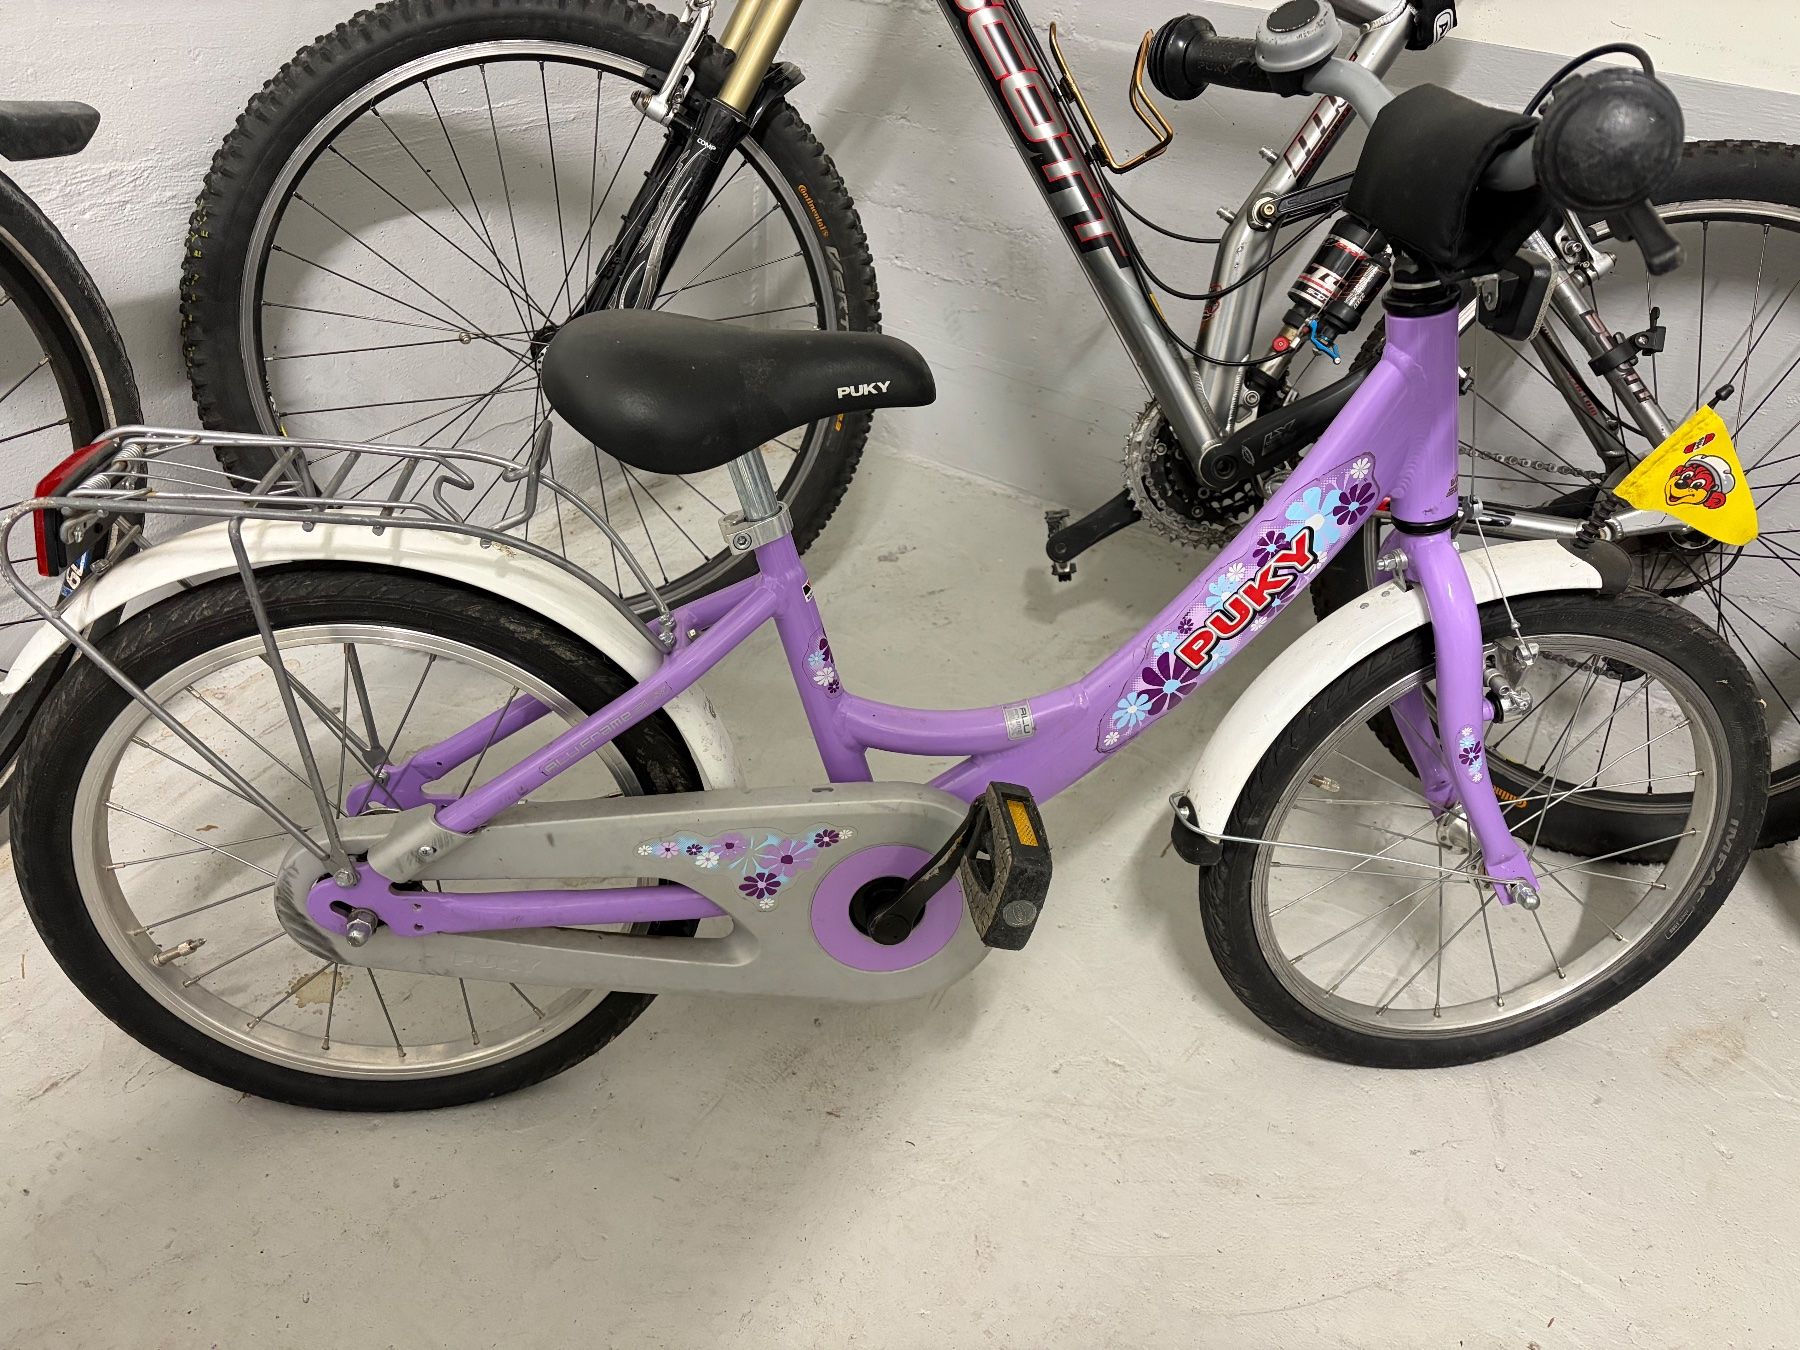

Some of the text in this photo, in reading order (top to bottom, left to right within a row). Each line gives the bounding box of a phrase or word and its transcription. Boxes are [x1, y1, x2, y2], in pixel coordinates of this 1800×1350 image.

[954, 0, 1129, 258] COTT
[696, 137, 717, 151] COMP
[837, 380, 891, 399] PUKY
[1174, 526, 1318, 670] PUKY
[1020, 707, 1031, 734] ALU
